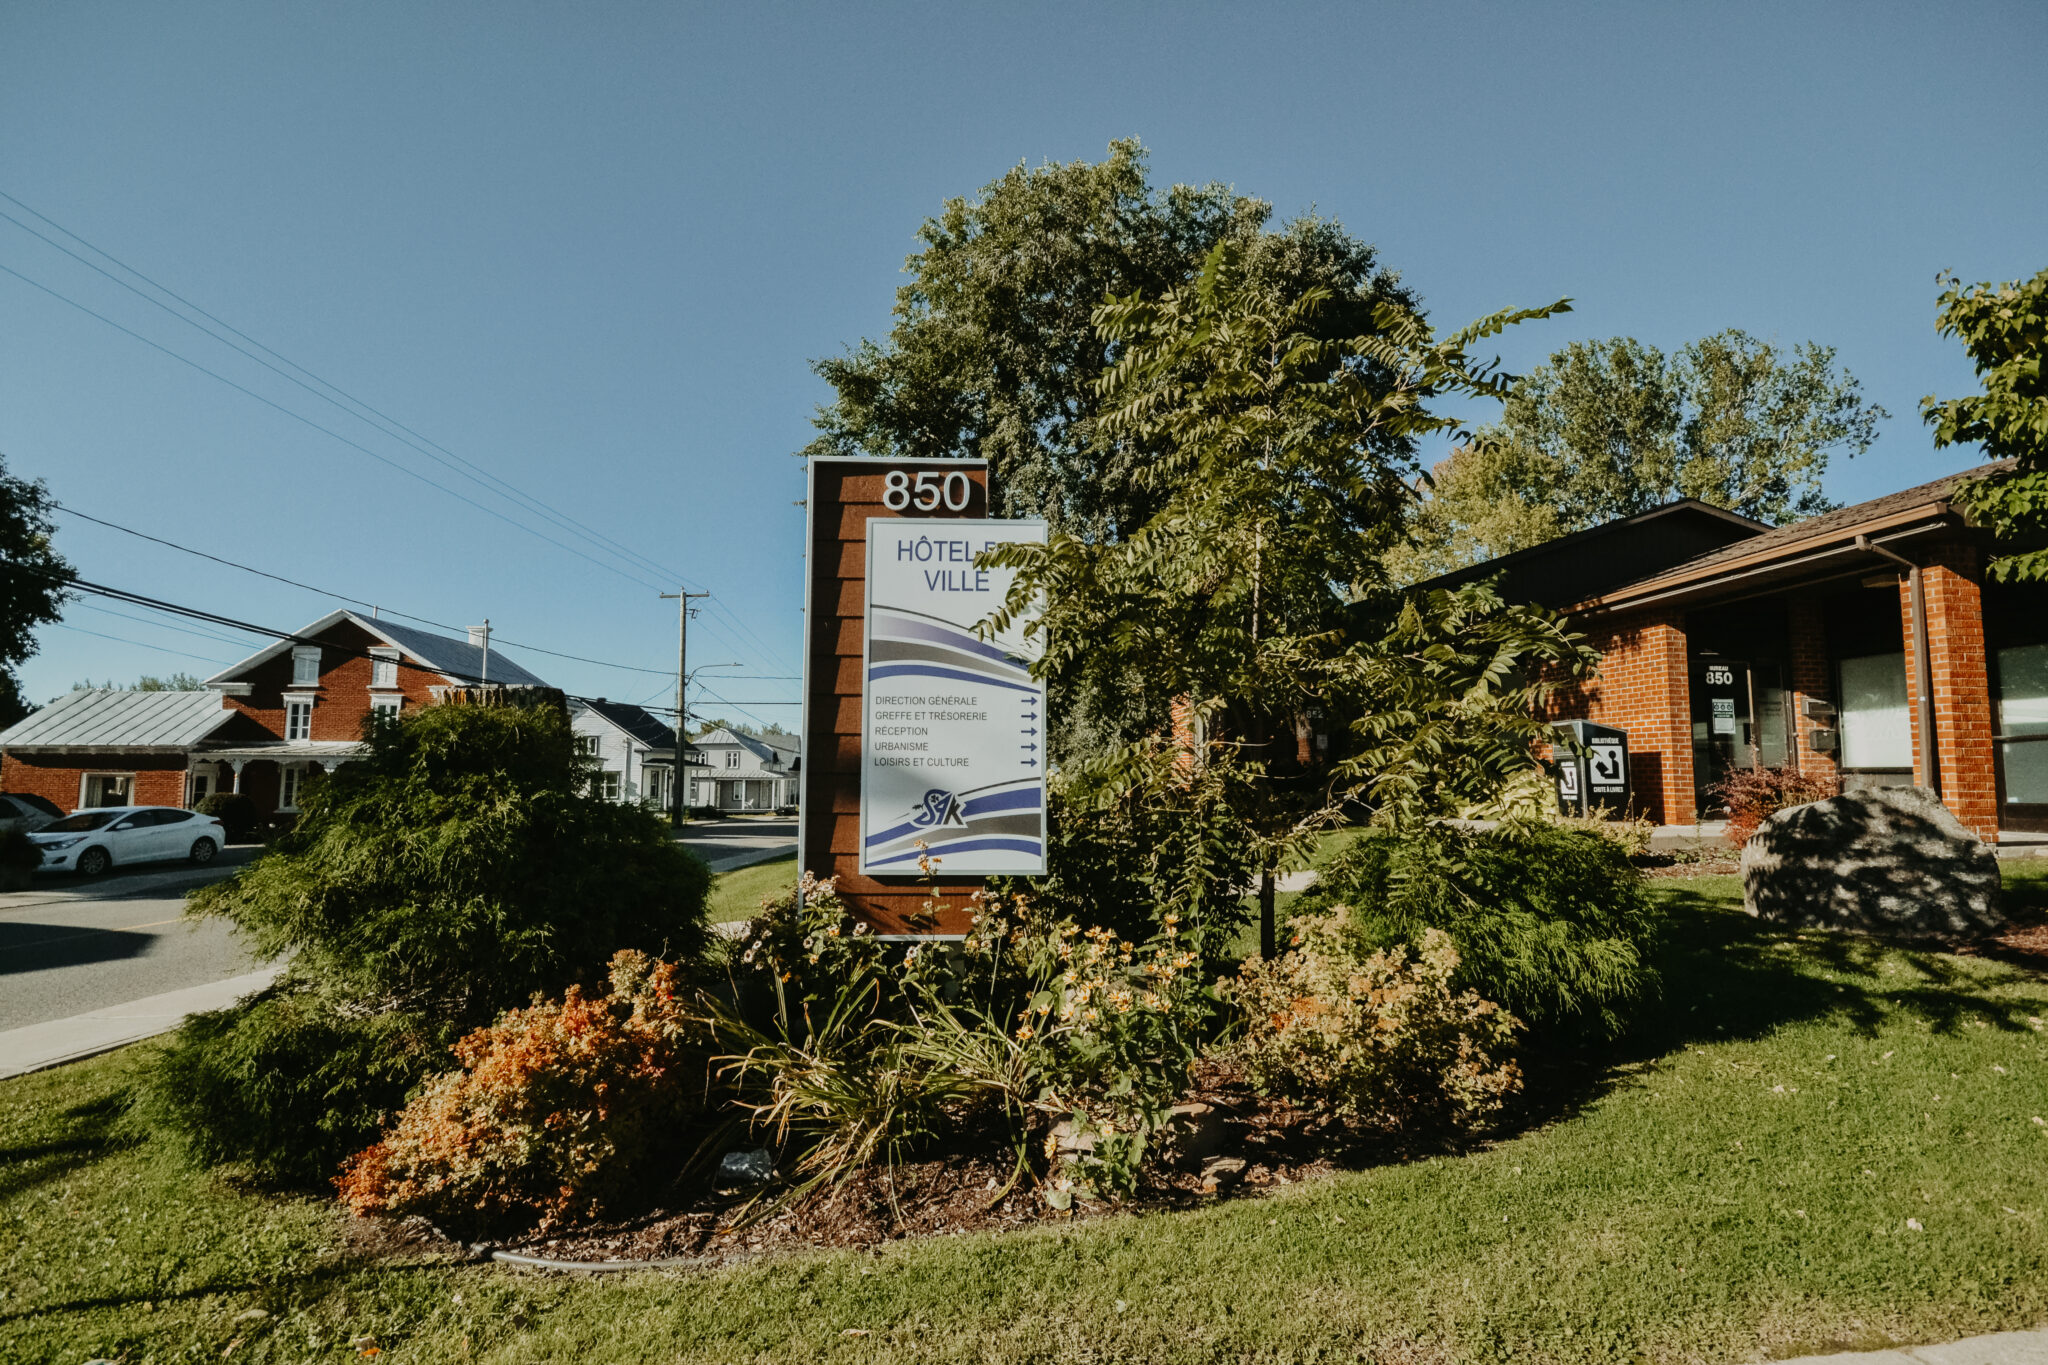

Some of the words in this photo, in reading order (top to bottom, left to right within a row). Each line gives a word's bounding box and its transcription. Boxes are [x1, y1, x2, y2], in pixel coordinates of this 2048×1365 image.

[882, 470, 971, 512] 850
[897, 535, 975, 562] HÔTEL
[924, 570, 990, 592] VILLE
[1706, 671, 1733, 685] 850
[875, 696, 926, 705] DIRECTION
[928, 694, 978, 706] GÉNÉRALE
[875, 711, 912, 721] GREFFE
[914, 711, 927, 721] ET
[928, 709, 988, 721] TRÉSORERIE
[875, 725, 928, 736] RÉCEPTION
[875, 742, 929, 751] URBANISME
[874, 757, 911, 767] LOISIRS
[913, 757, 925, 767] ET
[926, 757, 969, 767] CULTURE
